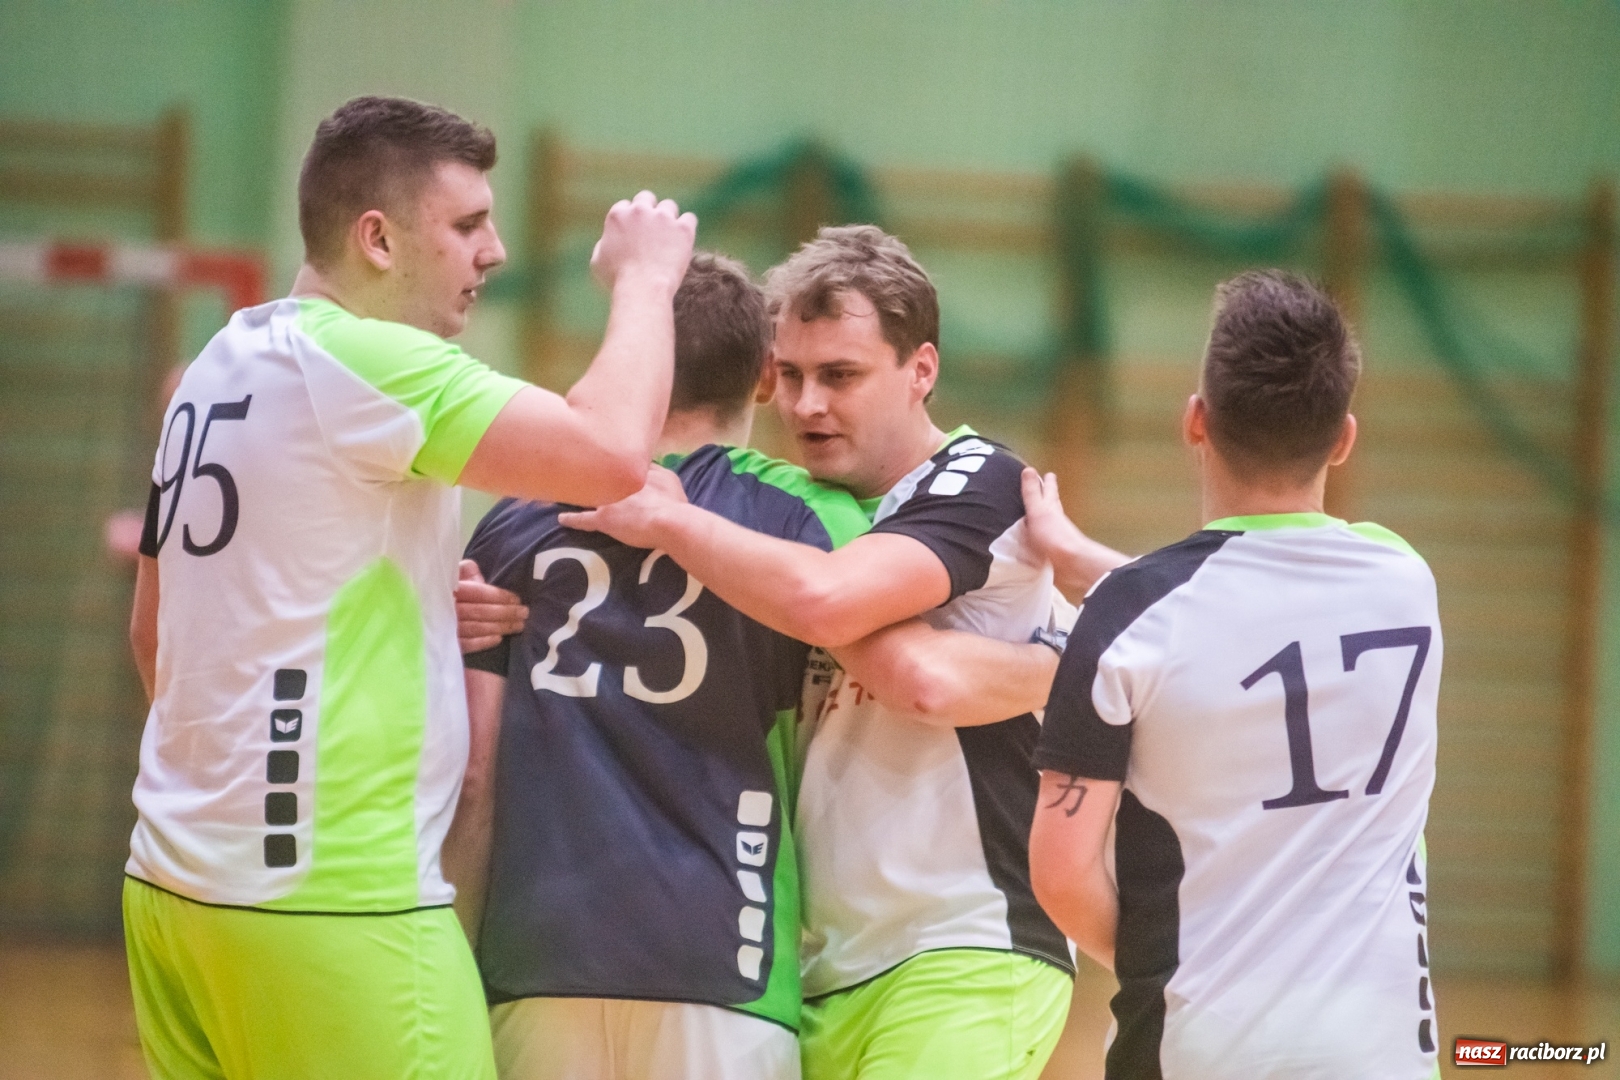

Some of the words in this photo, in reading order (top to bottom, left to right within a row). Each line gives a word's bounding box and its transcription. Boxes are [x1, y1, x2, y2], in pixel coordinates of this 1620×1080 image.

[157, 394, 252, 557] 95
[531, 547, 708, 704] 23
[1240, 626, 1431, 810] 17
